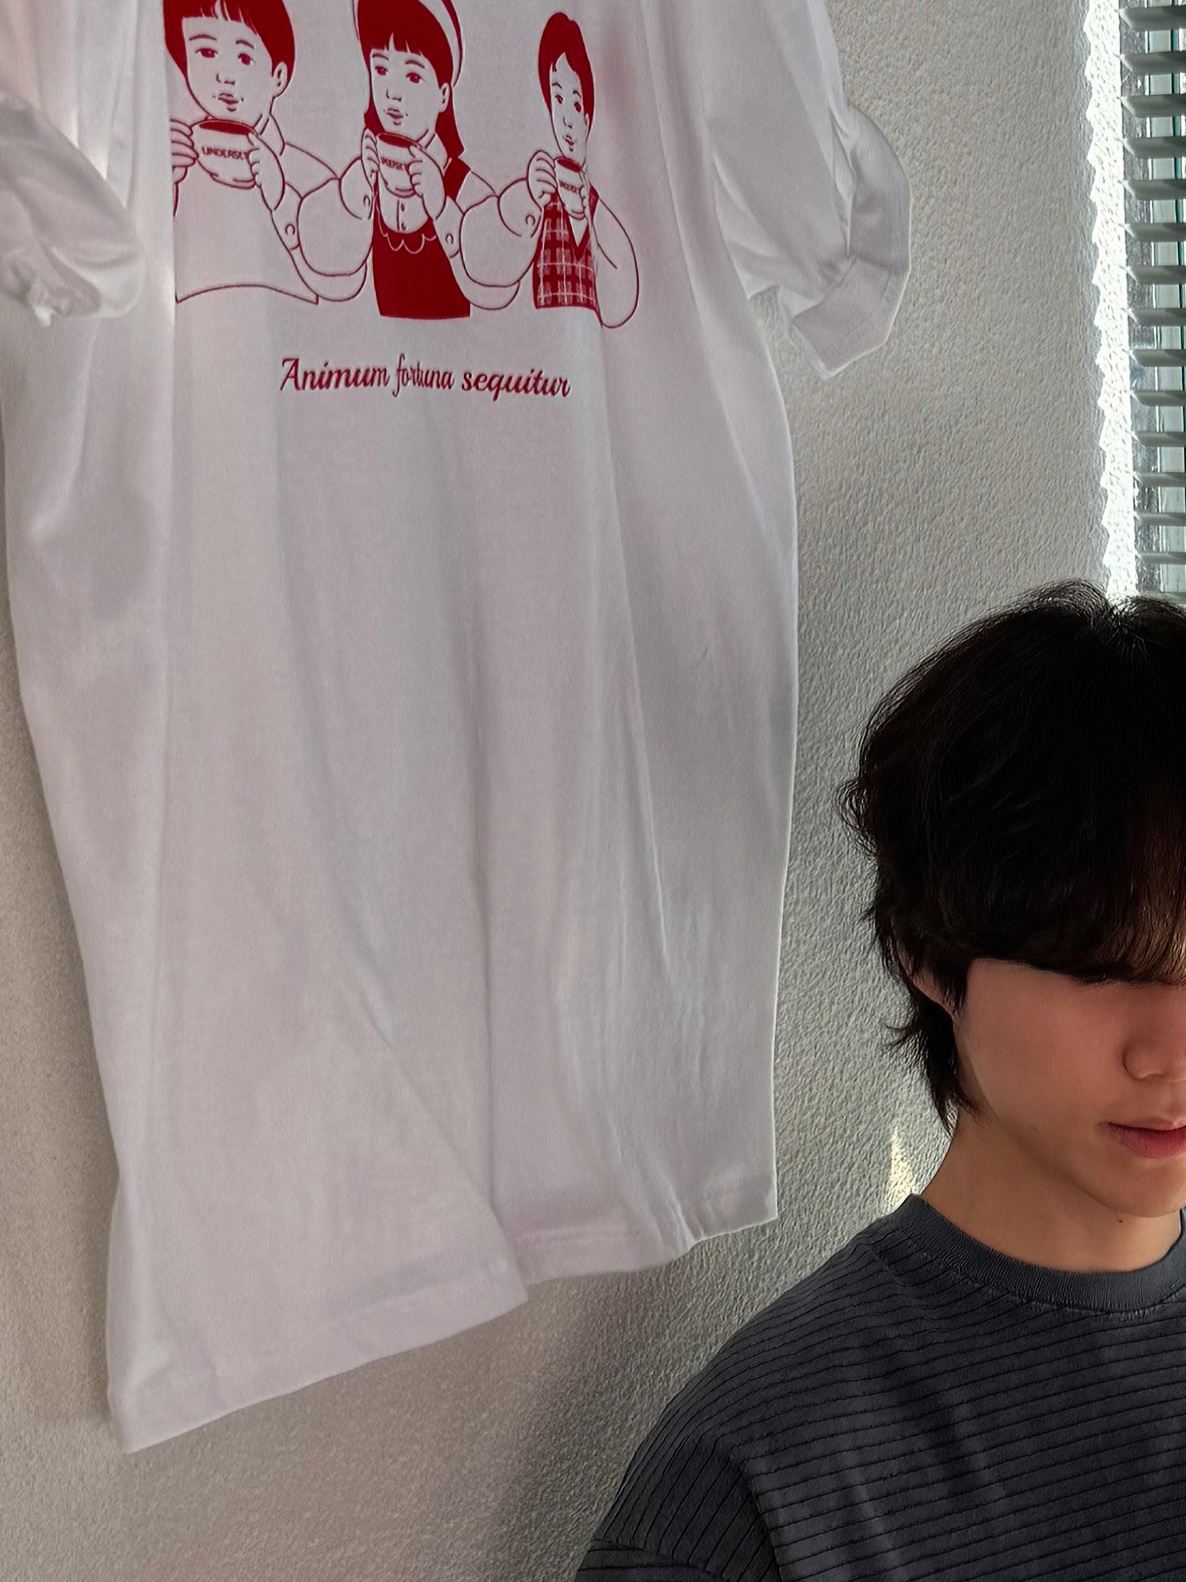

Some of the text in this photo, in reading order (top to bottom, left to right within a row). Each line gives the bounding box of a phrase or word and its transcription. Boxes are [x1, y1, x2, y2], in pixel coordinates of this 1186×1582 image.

[280, 353, 571, 401] Animum fortuna sequitur
